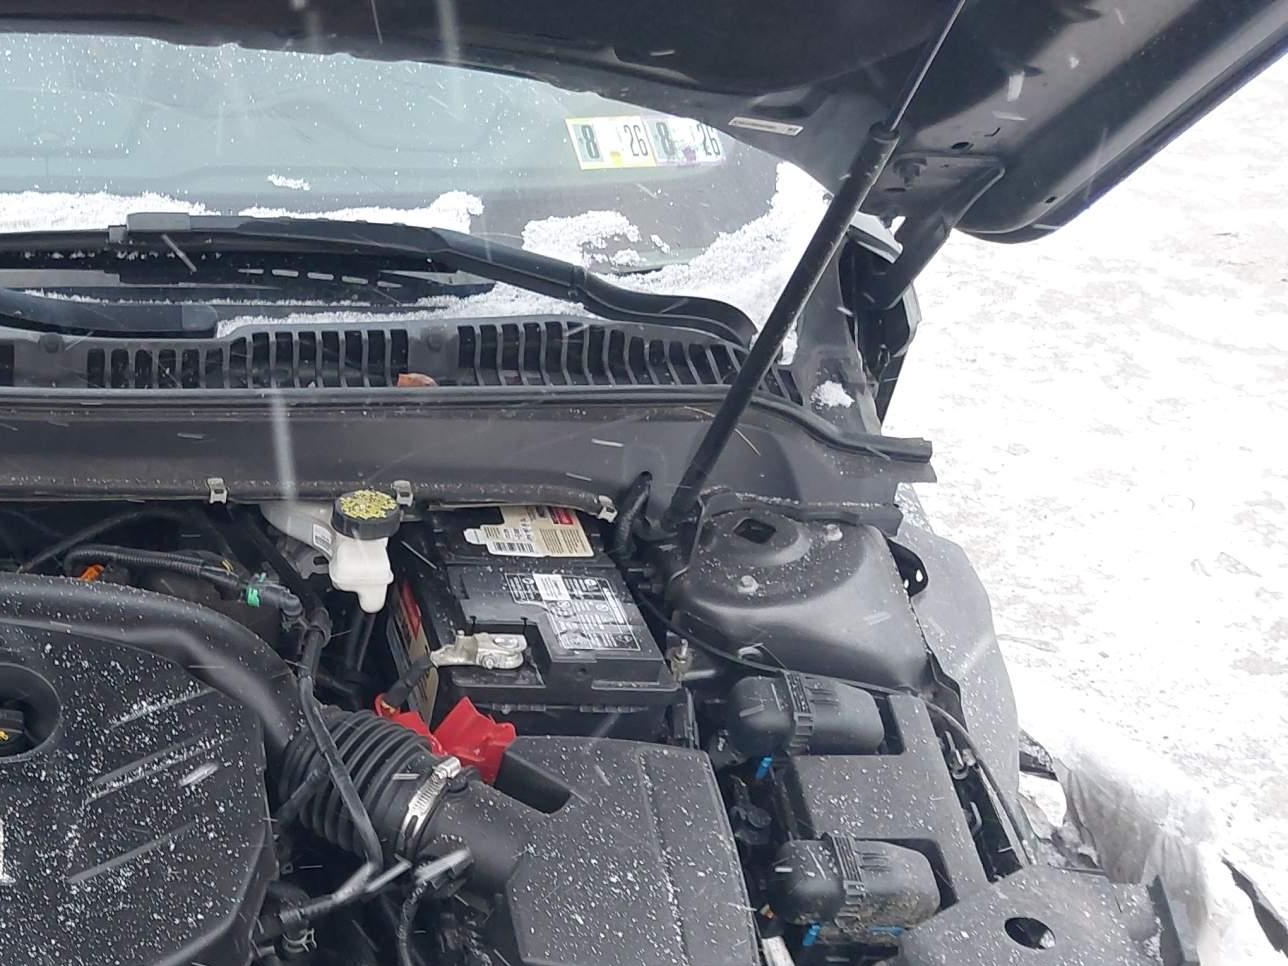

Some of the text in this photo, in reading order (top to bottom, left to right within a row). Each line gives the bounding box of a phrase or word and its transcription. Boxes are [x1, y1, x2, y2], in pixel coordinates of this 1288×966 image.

[581, 124, 649, 159] 8 26
[655, 121, 677, 156] 8
